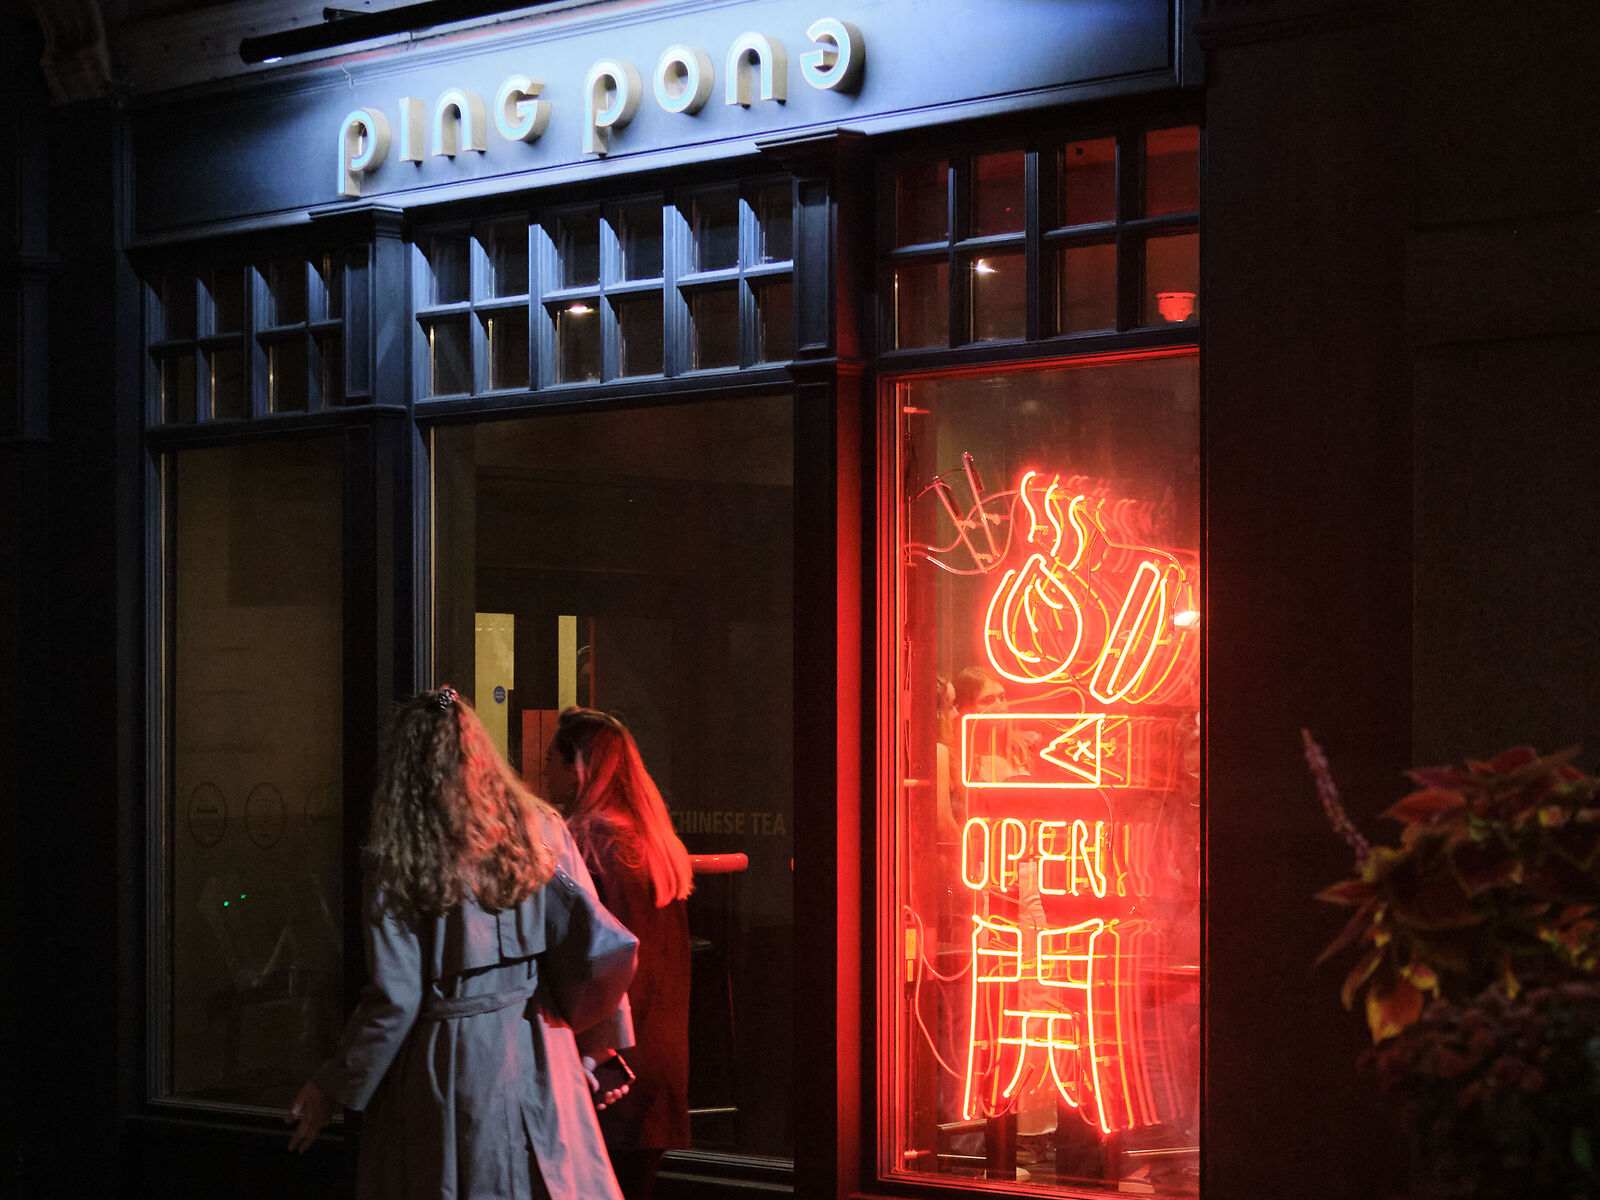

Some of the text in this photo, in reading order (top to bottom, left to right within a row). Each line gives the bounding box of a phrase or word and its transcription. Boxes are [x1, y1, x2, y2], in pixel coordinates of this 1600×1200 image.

[751, 813, 787, 836] TEA
[962, 816, 1107, 898] OPEN
[962, 914, 1112, 1134] 開
